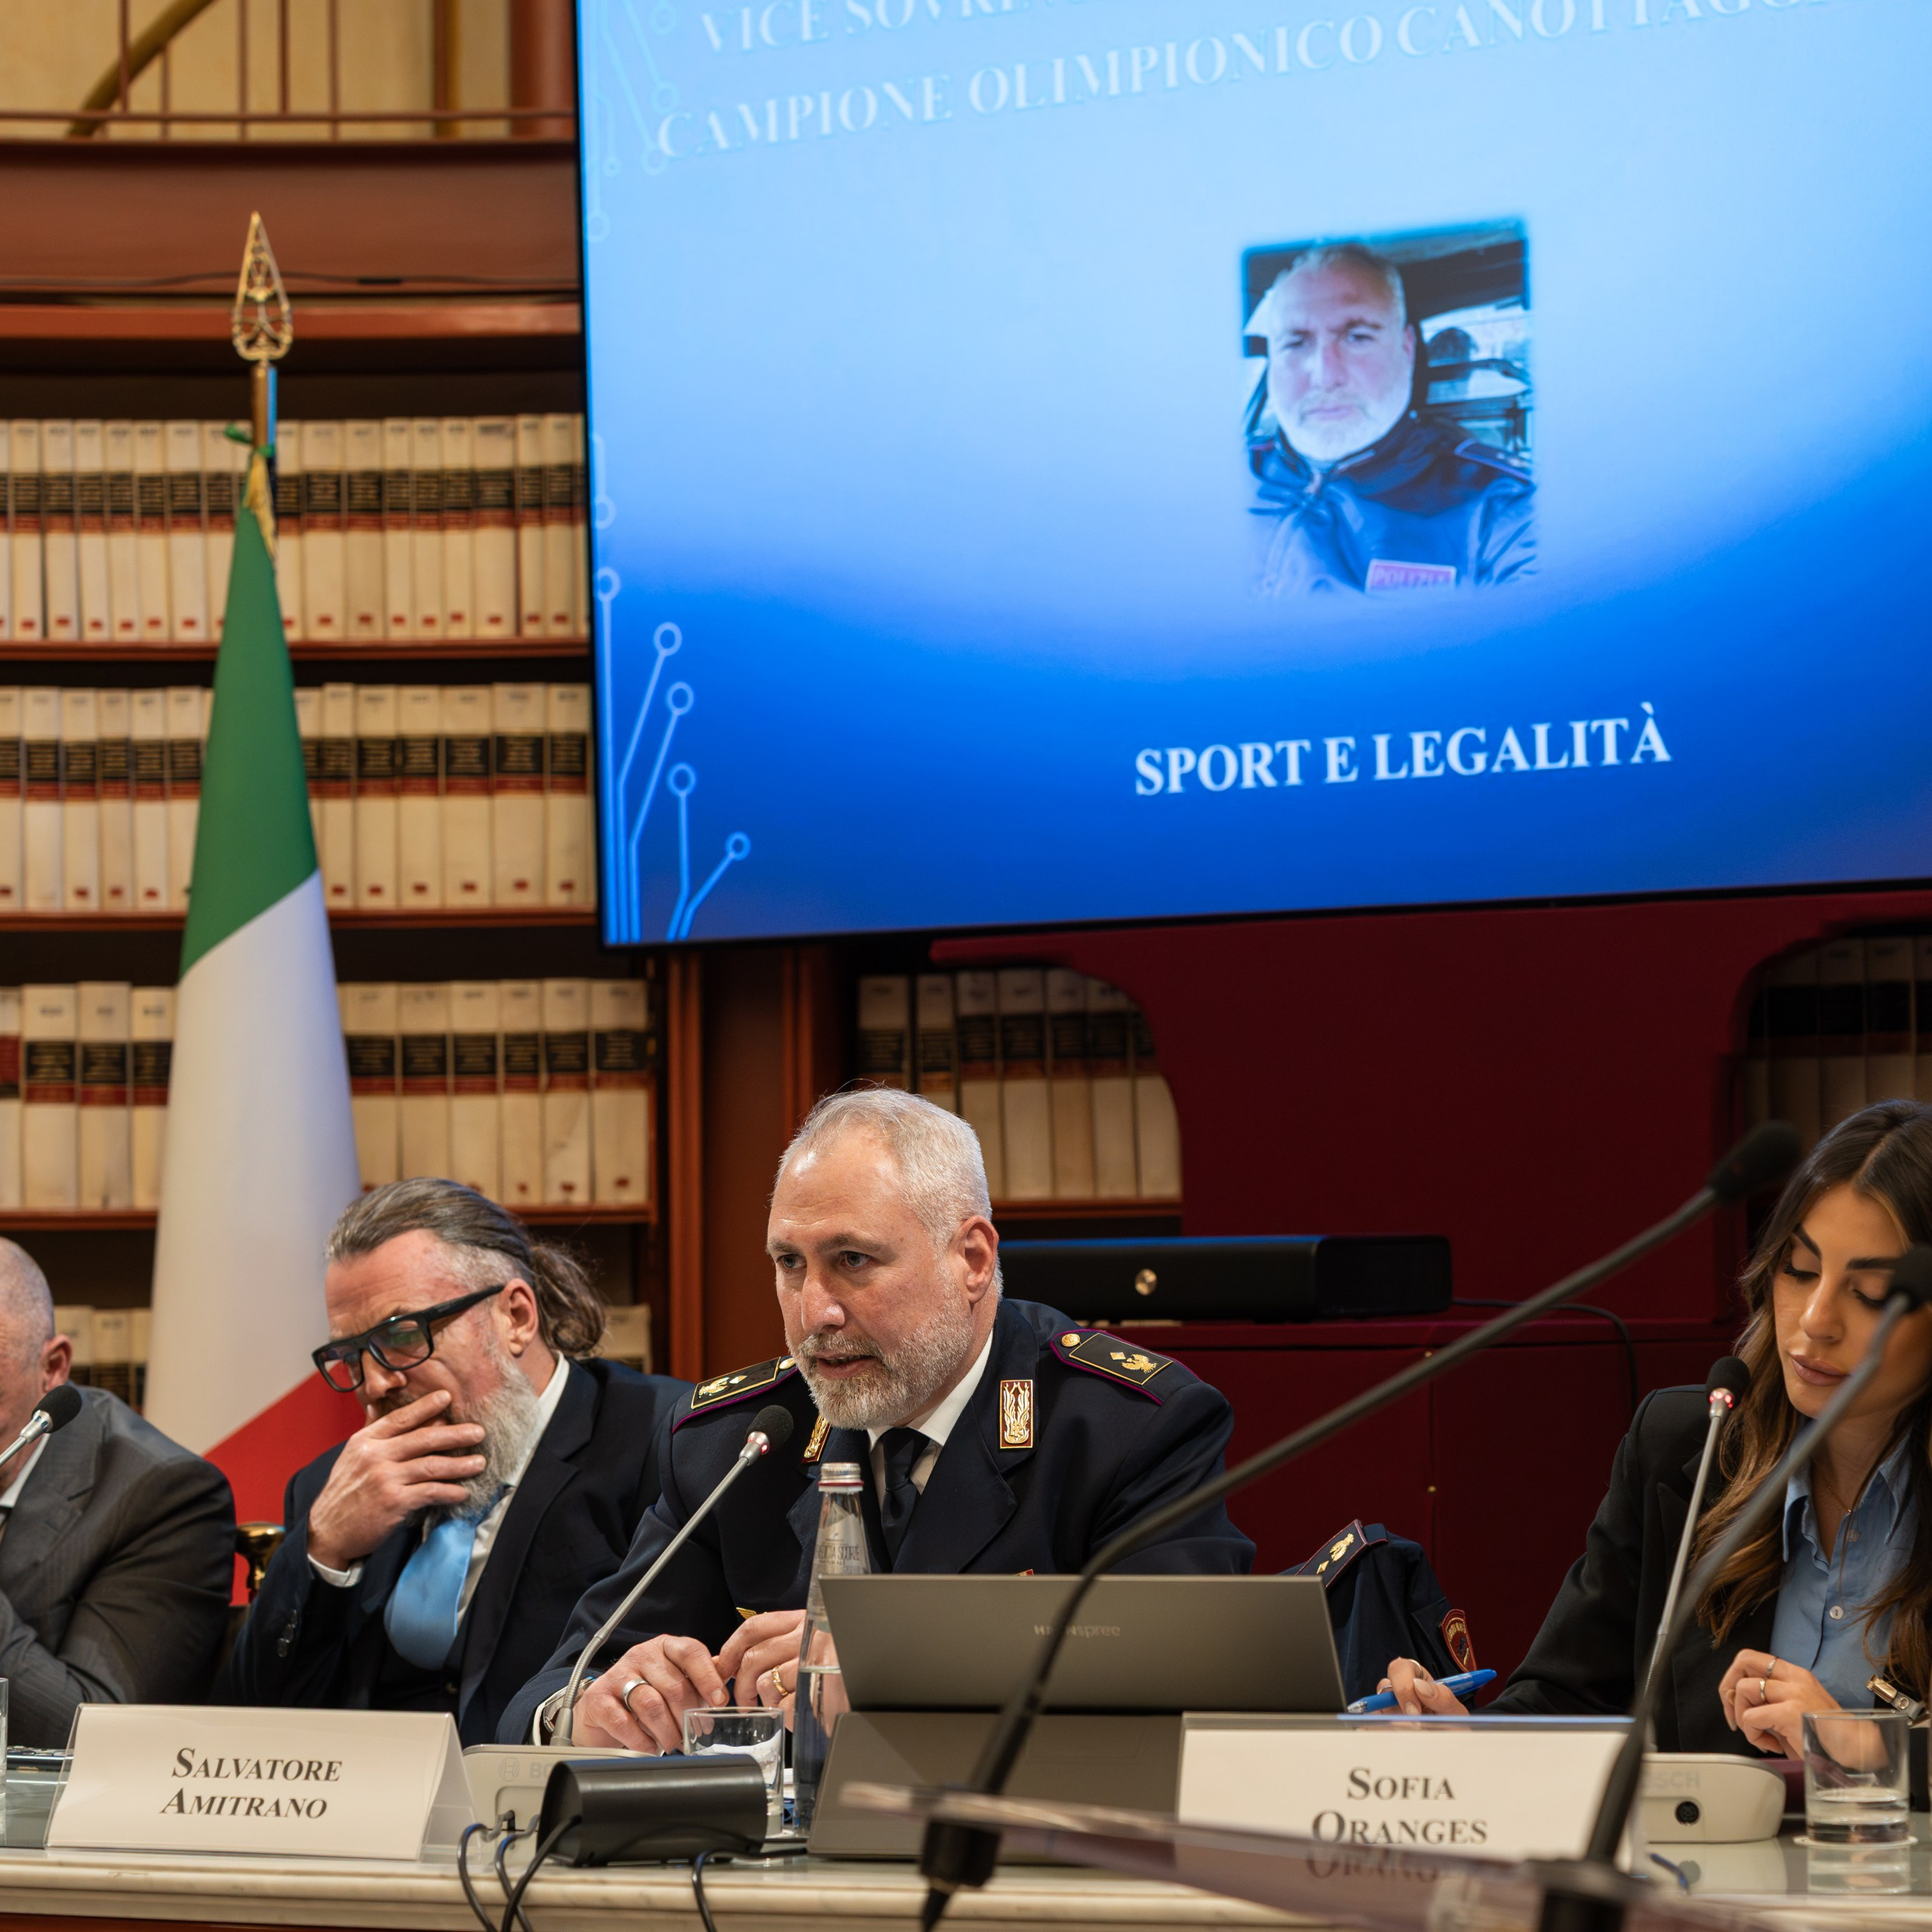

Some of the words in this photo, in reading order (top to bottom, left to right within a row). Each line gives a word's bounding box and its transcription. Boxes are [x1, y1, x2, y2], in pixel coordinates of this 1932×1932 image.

[697, 0, 830, 54] VICE
[657, 73, 953, 158] CAMPIONE
[967, 14, 1383, 115] OLIMPIONICO
[1134, 739, 1312, 796] SPORT
[1322, 736, 1359, 785] E
[1372, 701, 1672, 782] LEGALITÀ
[171, 1747, 343, 1783] SALVATORE
[1346, 1766, 1457, 1801] SOFIA
[158, 1786, 328, 1820] AMITRANO
[1311, 1809, 1488, 1845] ORANGES
